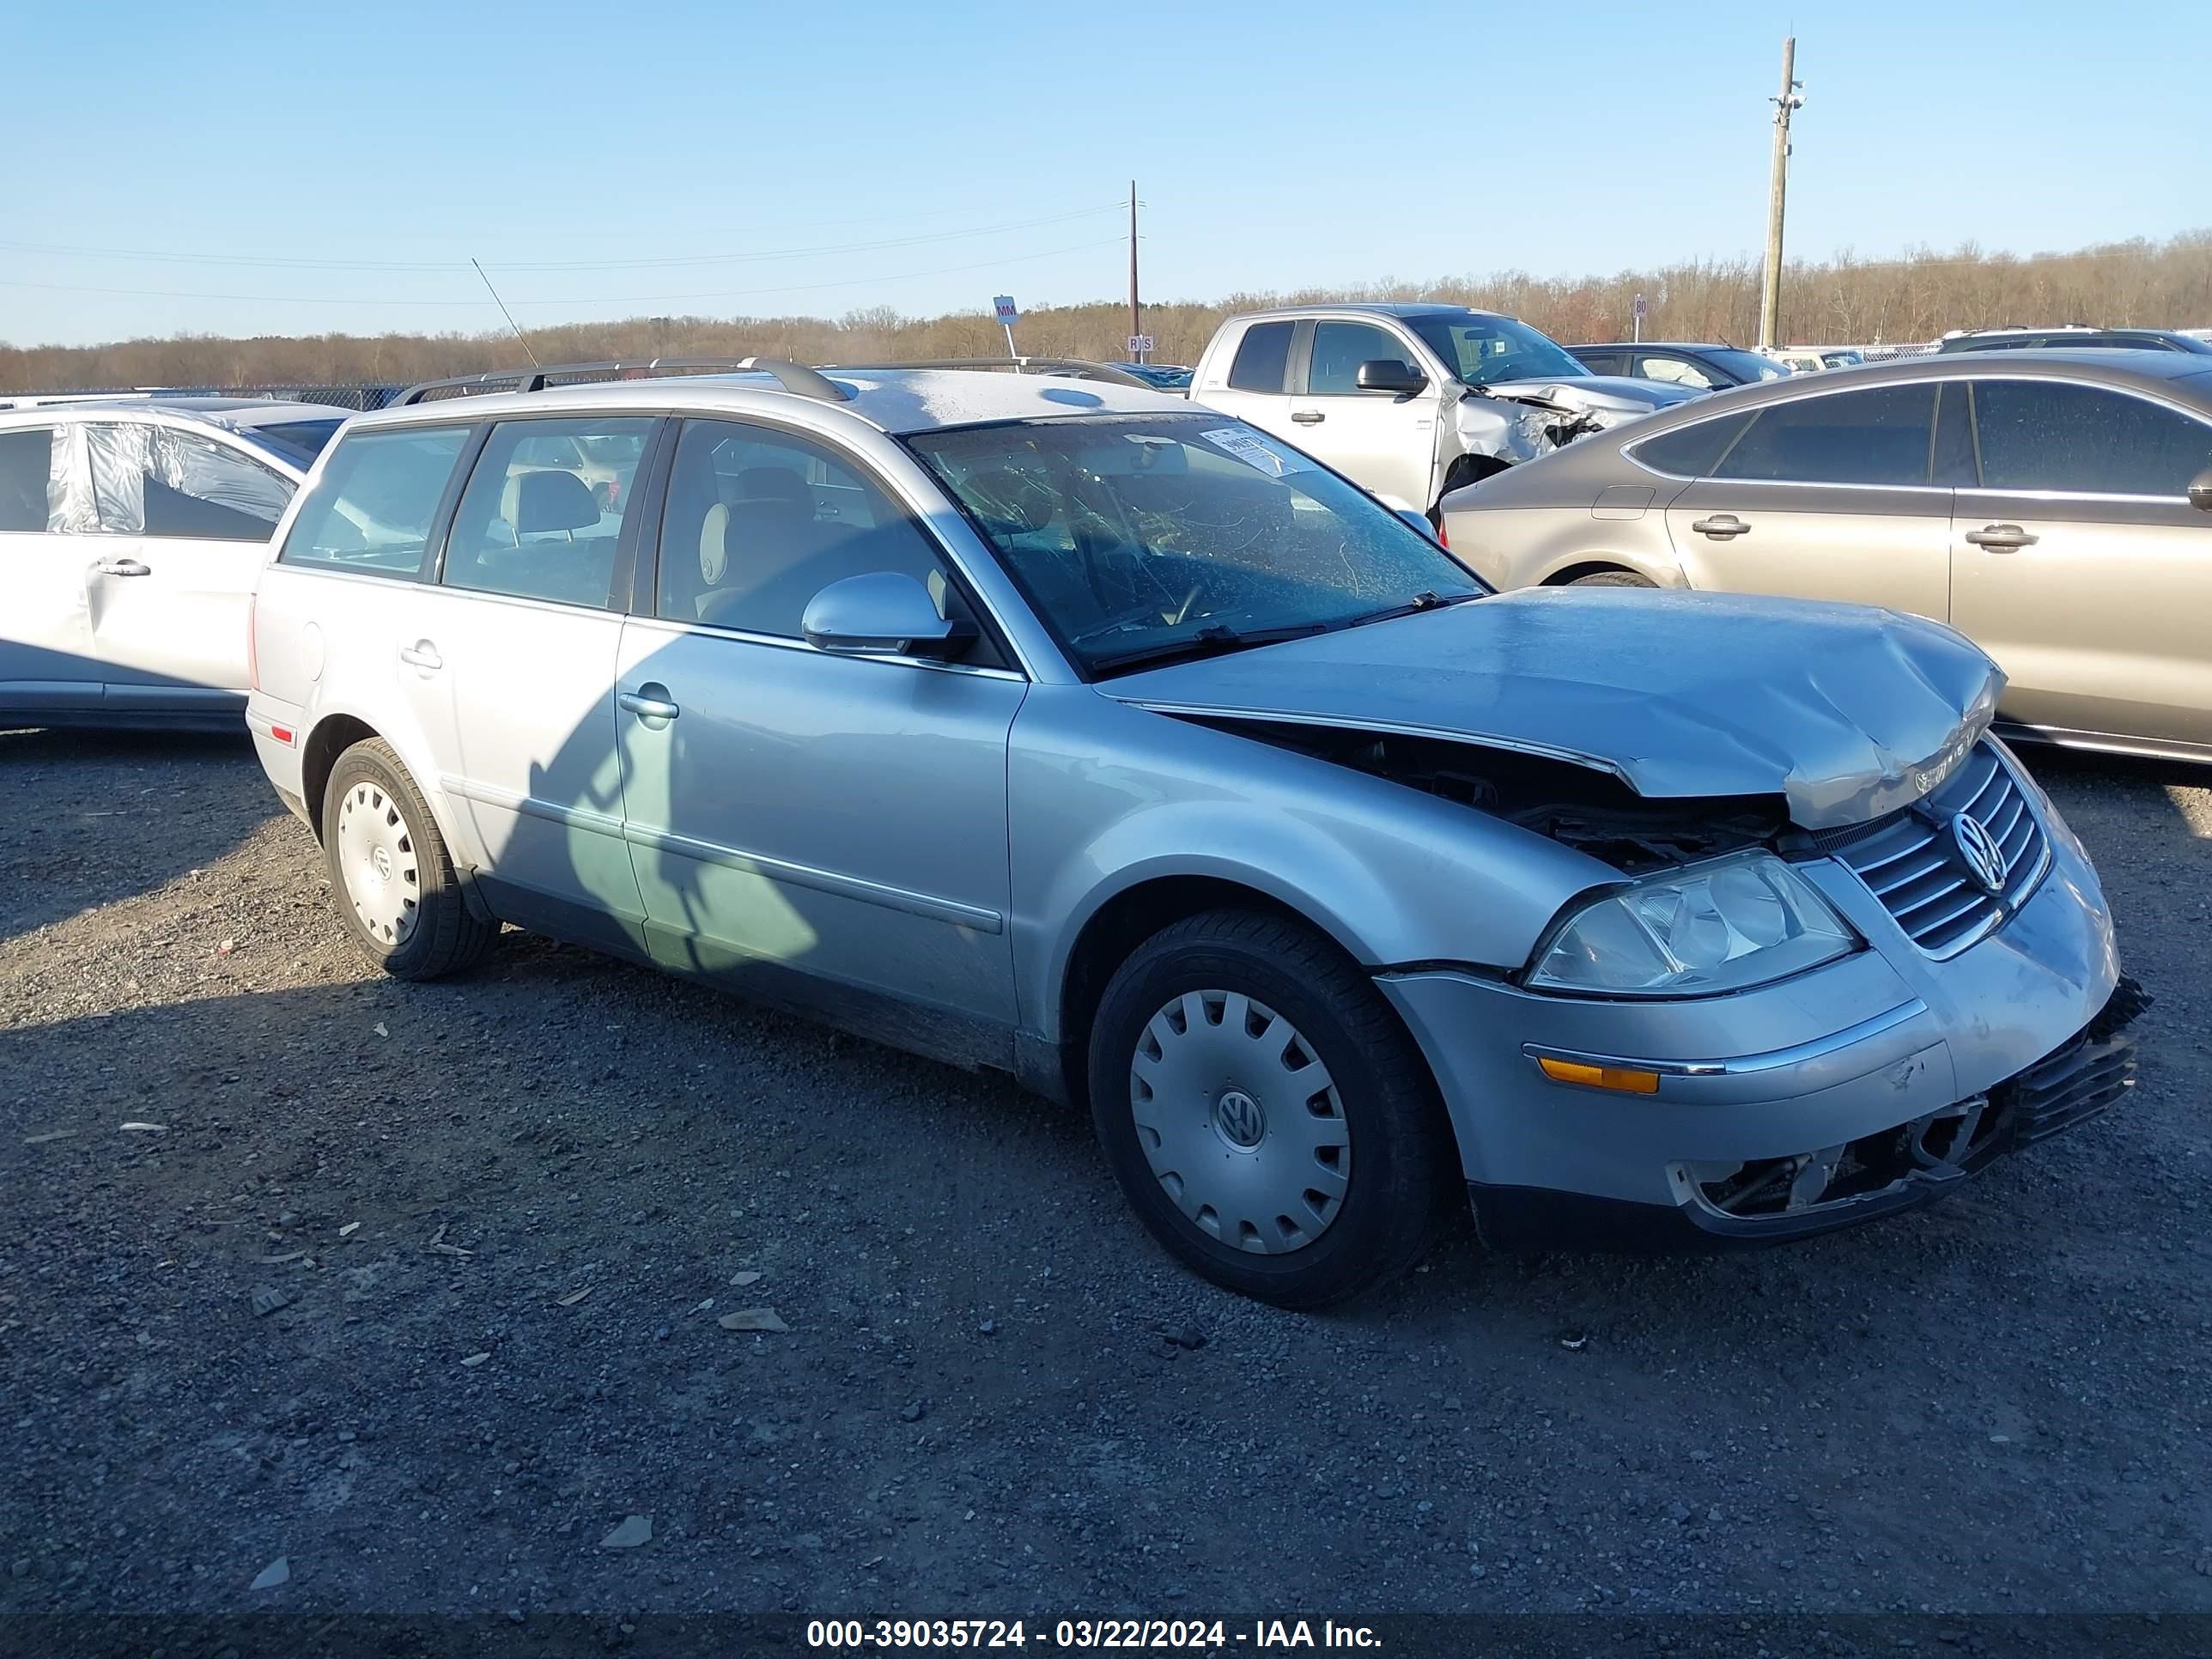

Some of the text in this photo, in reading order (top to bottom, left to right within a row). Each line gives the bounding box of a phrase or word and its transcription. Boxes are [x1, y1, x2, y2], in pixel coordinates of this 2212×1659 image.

[996, 305, 1017, 317] MM
[1636, 301, 1646, 313] 80
[1130, 338, 1138, 349] R
[1144, 337, 1152, 349] S
[1218, 1091, 1264, 1147] VW
